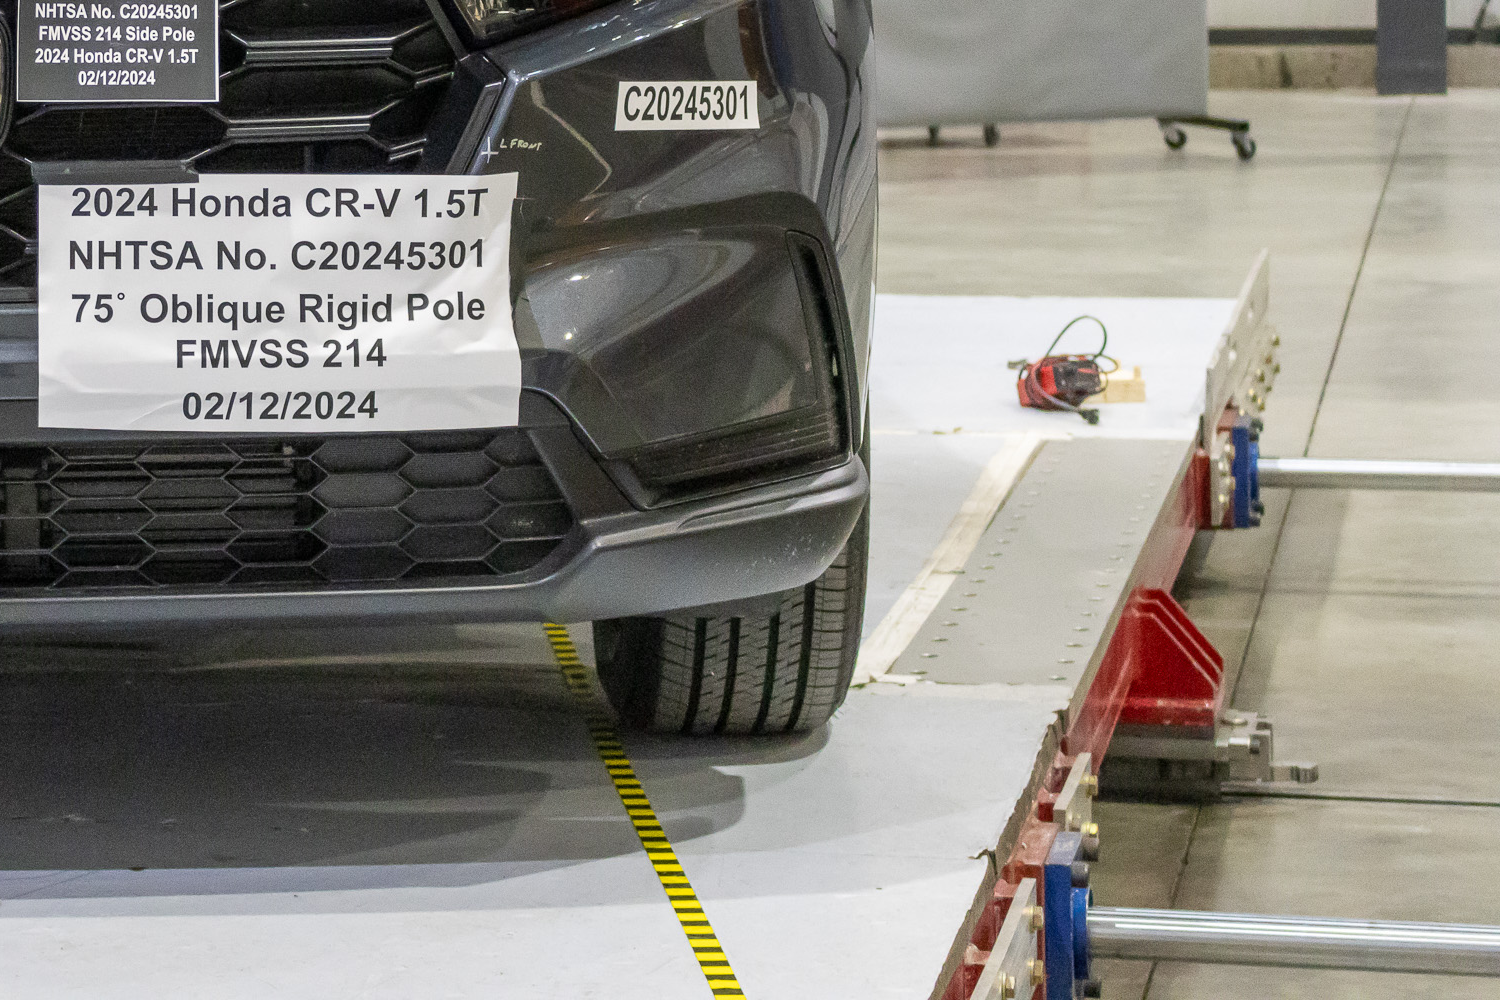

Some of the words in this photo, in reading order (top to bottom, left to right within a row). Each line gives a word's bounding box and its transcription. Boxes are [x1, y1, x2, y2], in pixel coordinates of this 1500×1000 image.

[34, 2, 89, 20] NHTSA
[91, 3, 117, 20] No.
[119, 3, 199, 20] C20245301
[38, 25, 92, 42] FMVSS
[95, 25, 122, 42] 214
[125, 25, 160, 42] Side
[162, 26, 196, 42] Pole
[34, 47, 70, 64] 2024
[73, 47, 122, 64] Honda
[125, 47, 164, 64] CR-V
[167, 48, 199, 64] 1.5T
[77, 69, 157, 86] 02/12/2024
[623, 85, 749, 122] C20245301
[71, 187, 158, 218] 2024
[171, 187, 292, 218] Honda
[304, 187, 402, 218] CR-V
[413, 187, 489, 219] 1.5T
[69, 240, 204, 271] NHTSA
[216, 240, 278, 271] No.
[290, 239, 485, 271] C20245301
[139, 293, 286, 331] Oblique
[299, 293, 394, 331] Rigid
[406, 291, 486, 322] Pole
[176, 338, 310, 369] FMVSS
[322, 338, 388, 369] 214
[182, 390, 380, 421] 02/12/2024
